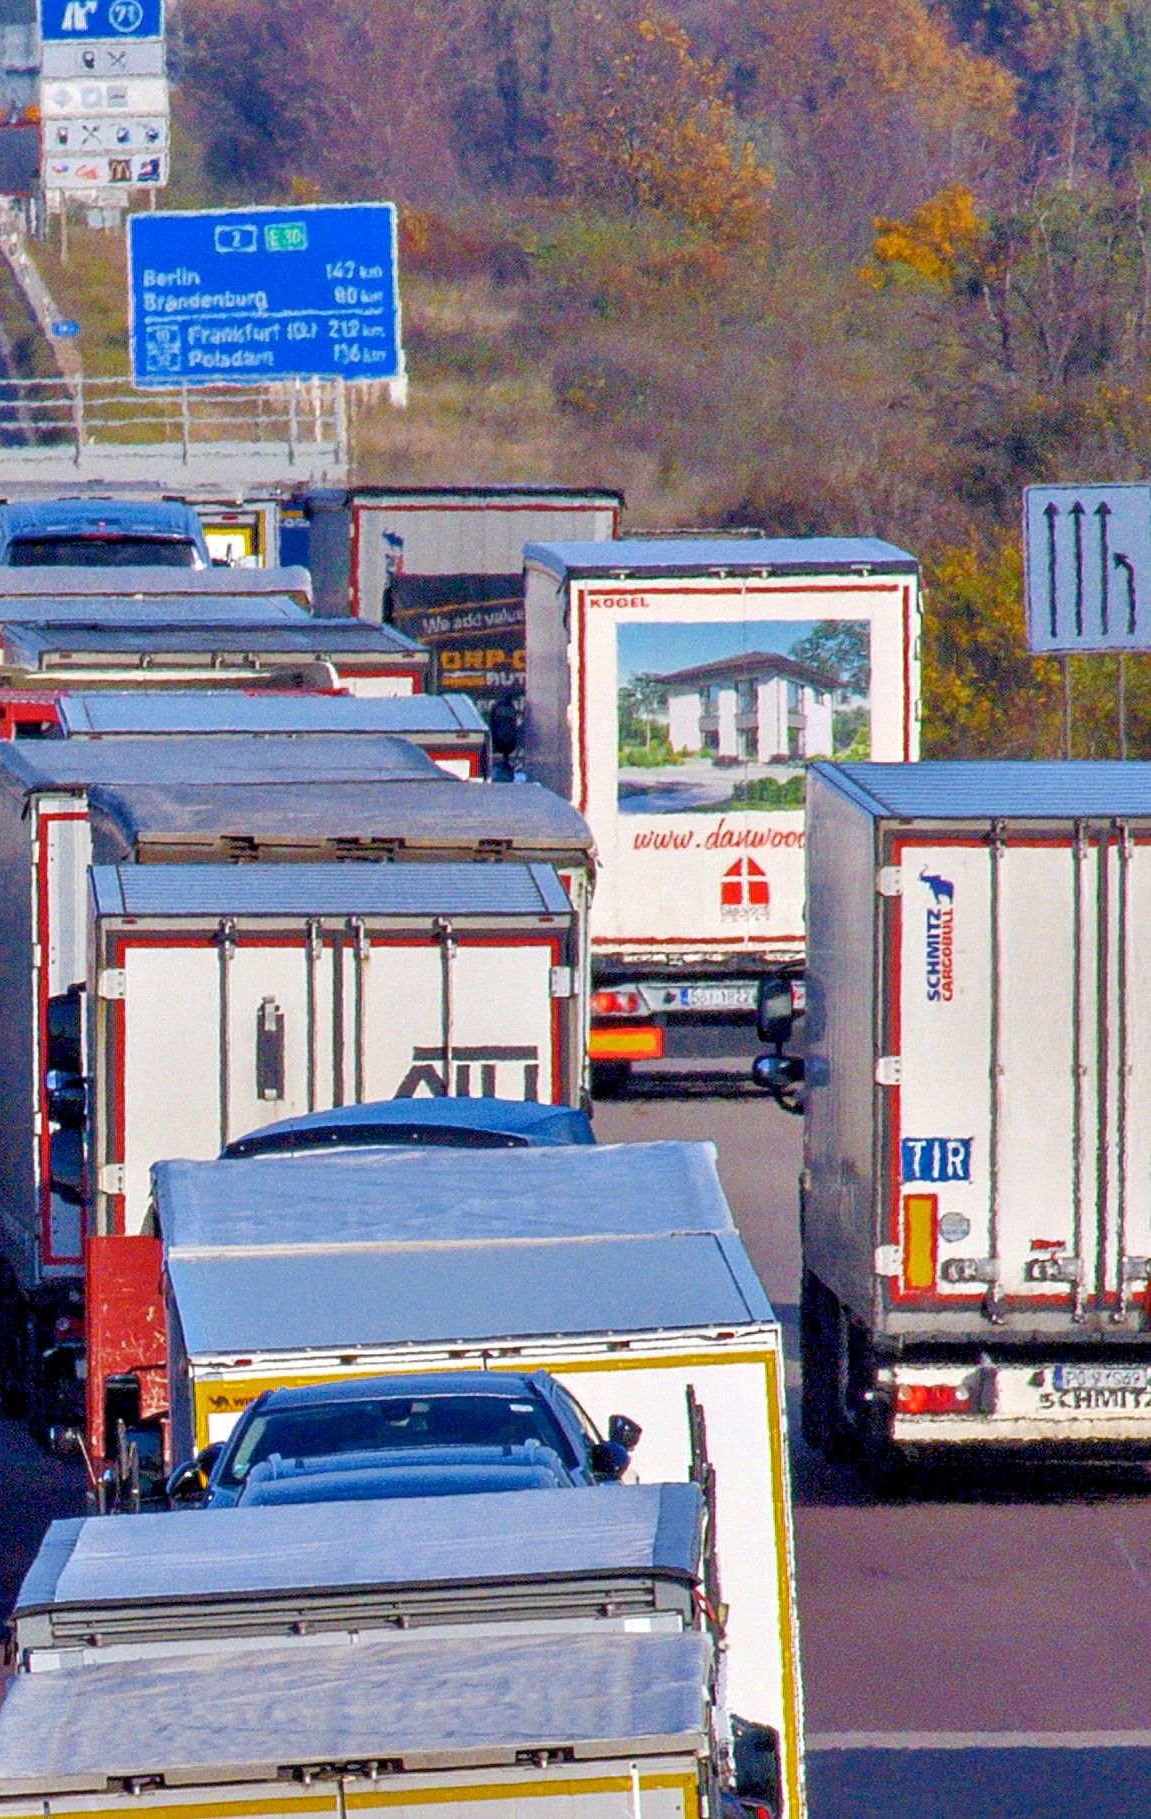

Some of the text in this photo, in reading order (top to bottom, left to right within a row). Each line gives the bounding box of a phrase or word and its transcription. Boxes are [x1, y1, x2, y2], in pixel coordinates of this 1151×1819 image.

[114, 4, 135, 24] 71
[143, 266, 201, 287] Berlin
[358, 265, 383, 280] km
[143, 291, 268, 316] Brandenburg
[359, 288, 384, 303] km
[187, 323, 280, 345] Frankfurt
[362, 323, 385, 338] km
[187, 350, 275, 369] Potsdam
[362, 347, 387, 363] km
[926, 908, 941, 1002] SCHMITZ
[942, 907, 954, 1002] CARGOBULL
[906, 1141, 965, 1178] TIR
